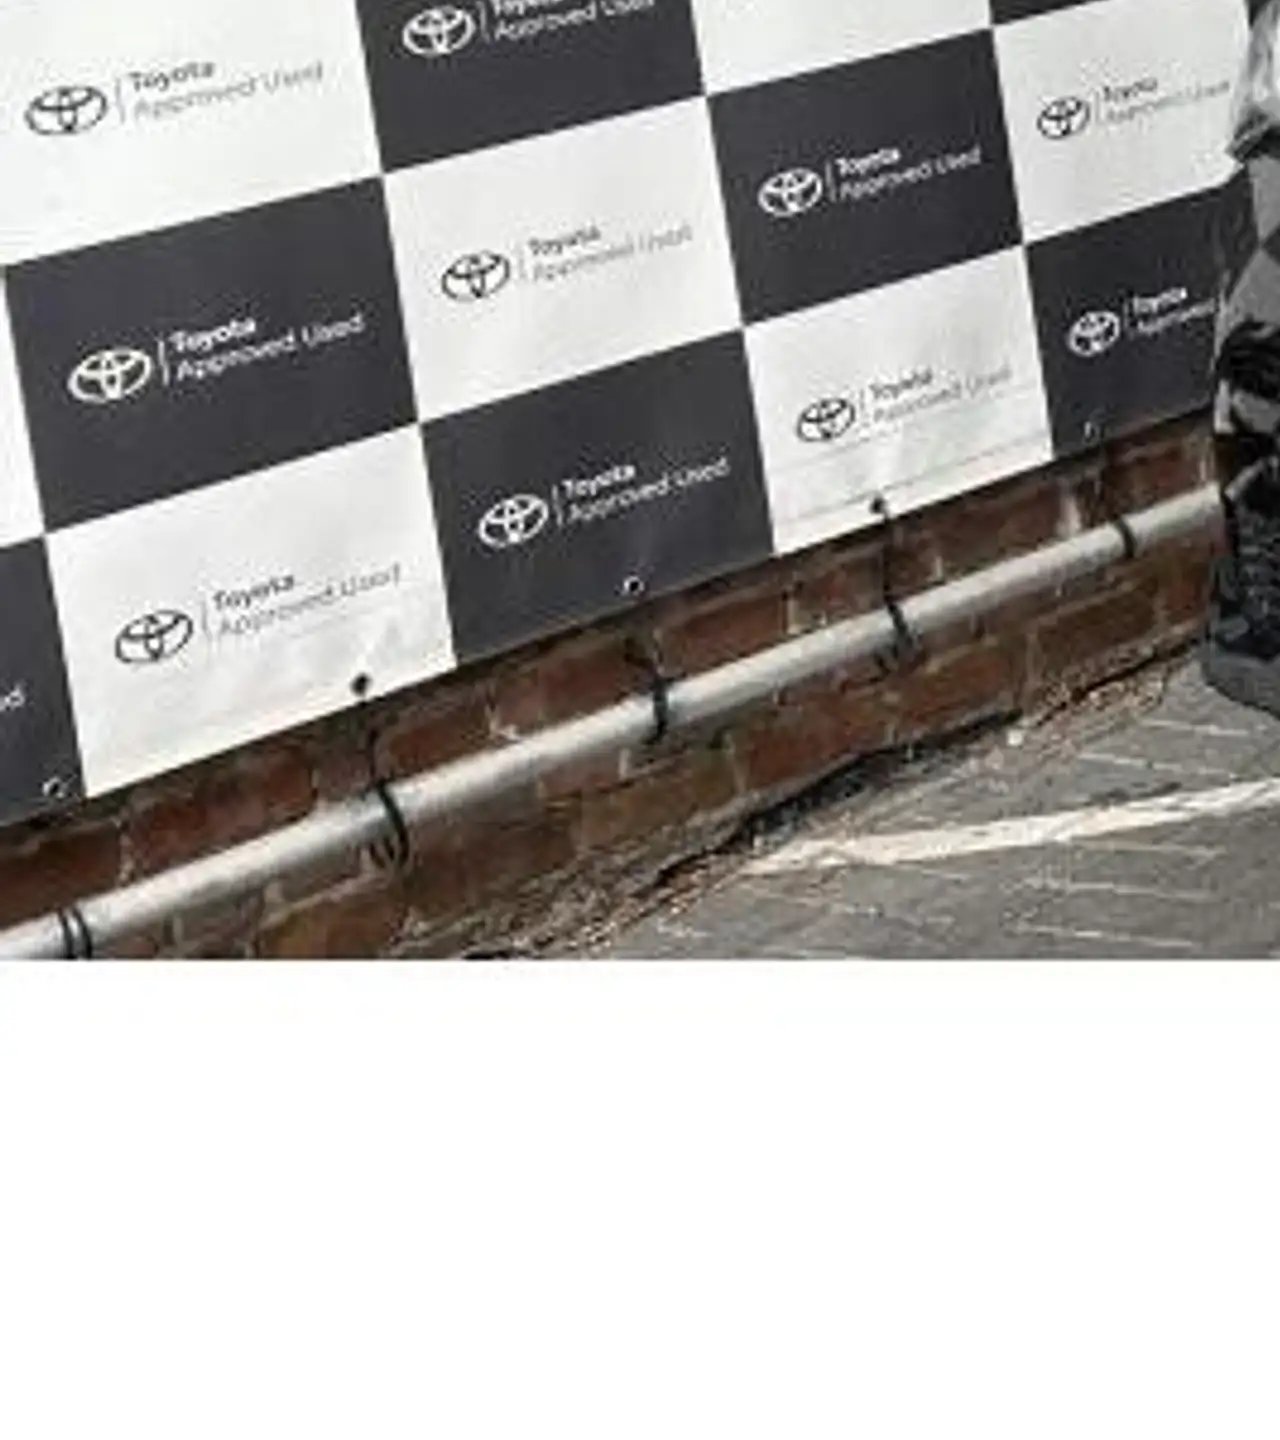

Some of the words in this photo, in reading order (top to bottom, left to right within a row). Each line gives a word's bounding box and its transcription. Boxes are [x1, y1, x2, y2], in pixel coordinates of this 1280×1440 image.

[128, 61, 215, 93] Toyota
[169, 317, 257, 353] Toyota
[176, 328, 297, 382] Approved
[302, 313, 366, 349] Used
[561, 465, 637, 500] Toyota
